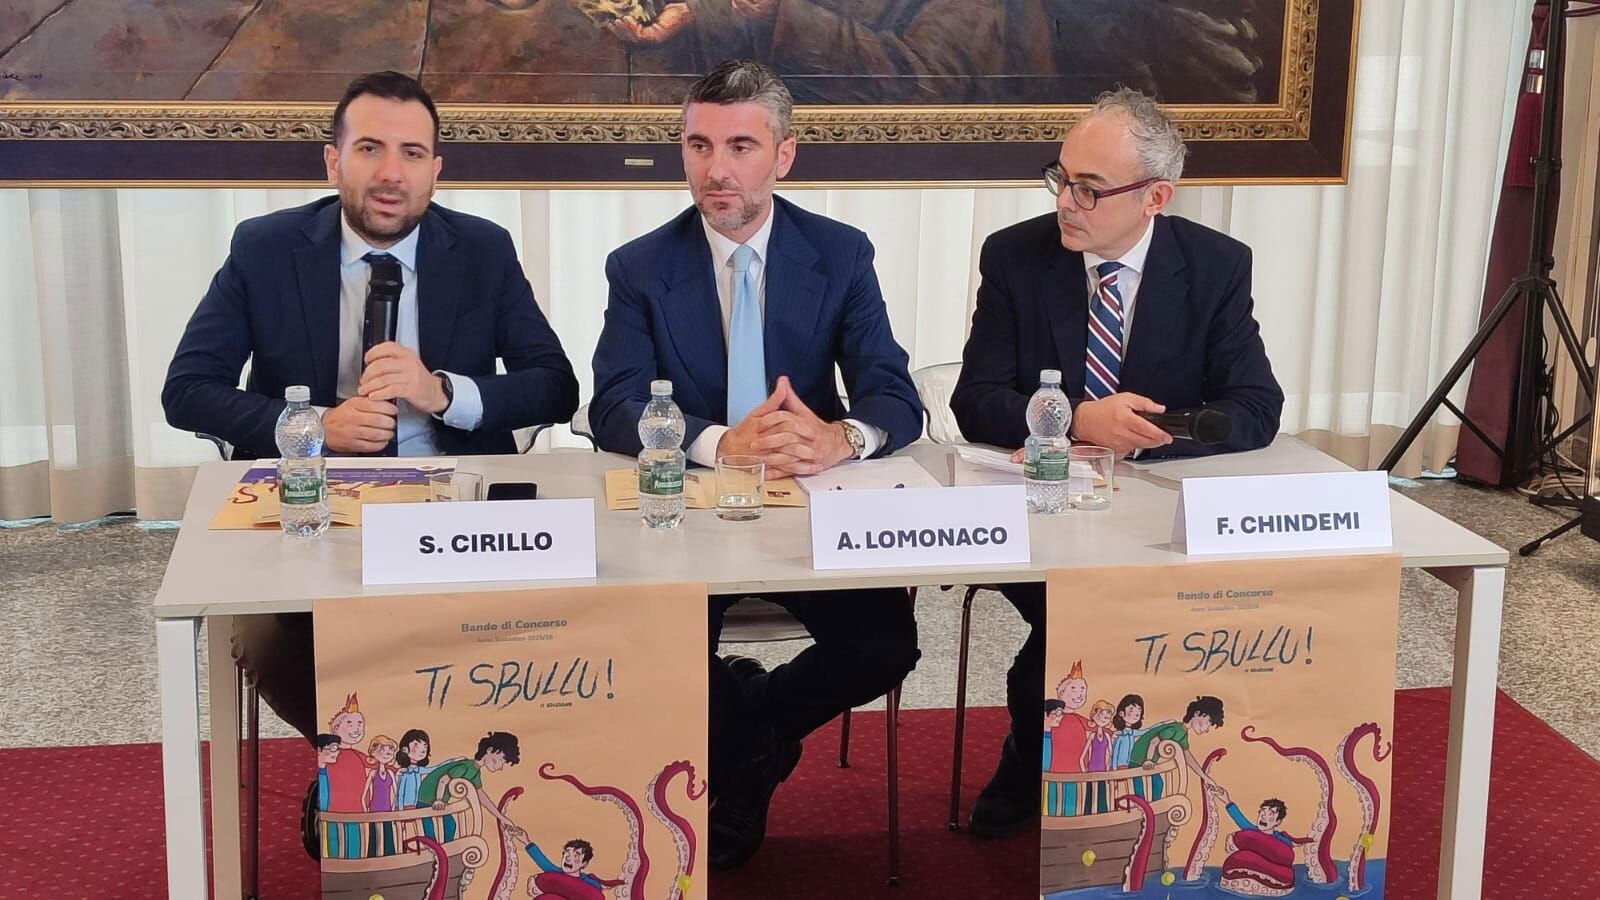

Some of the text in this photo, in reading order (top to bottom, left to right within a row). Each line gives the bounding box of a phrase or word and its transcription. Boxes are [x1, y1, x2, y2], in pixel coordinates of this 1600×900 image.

[1216, 511, 1360, 535] F. CHINDEMI
[419, 531, 553, 555] S. CIRILLO
[836, 526, 1008, 551] A. LOMONACO
[1176, 589, 1274, 601] Bando di Concorso
[461, 619, 568, 632] Bando di Concorso
[1135, 632, 1170, 676] TI
[415, 663, 454, 709] TI
